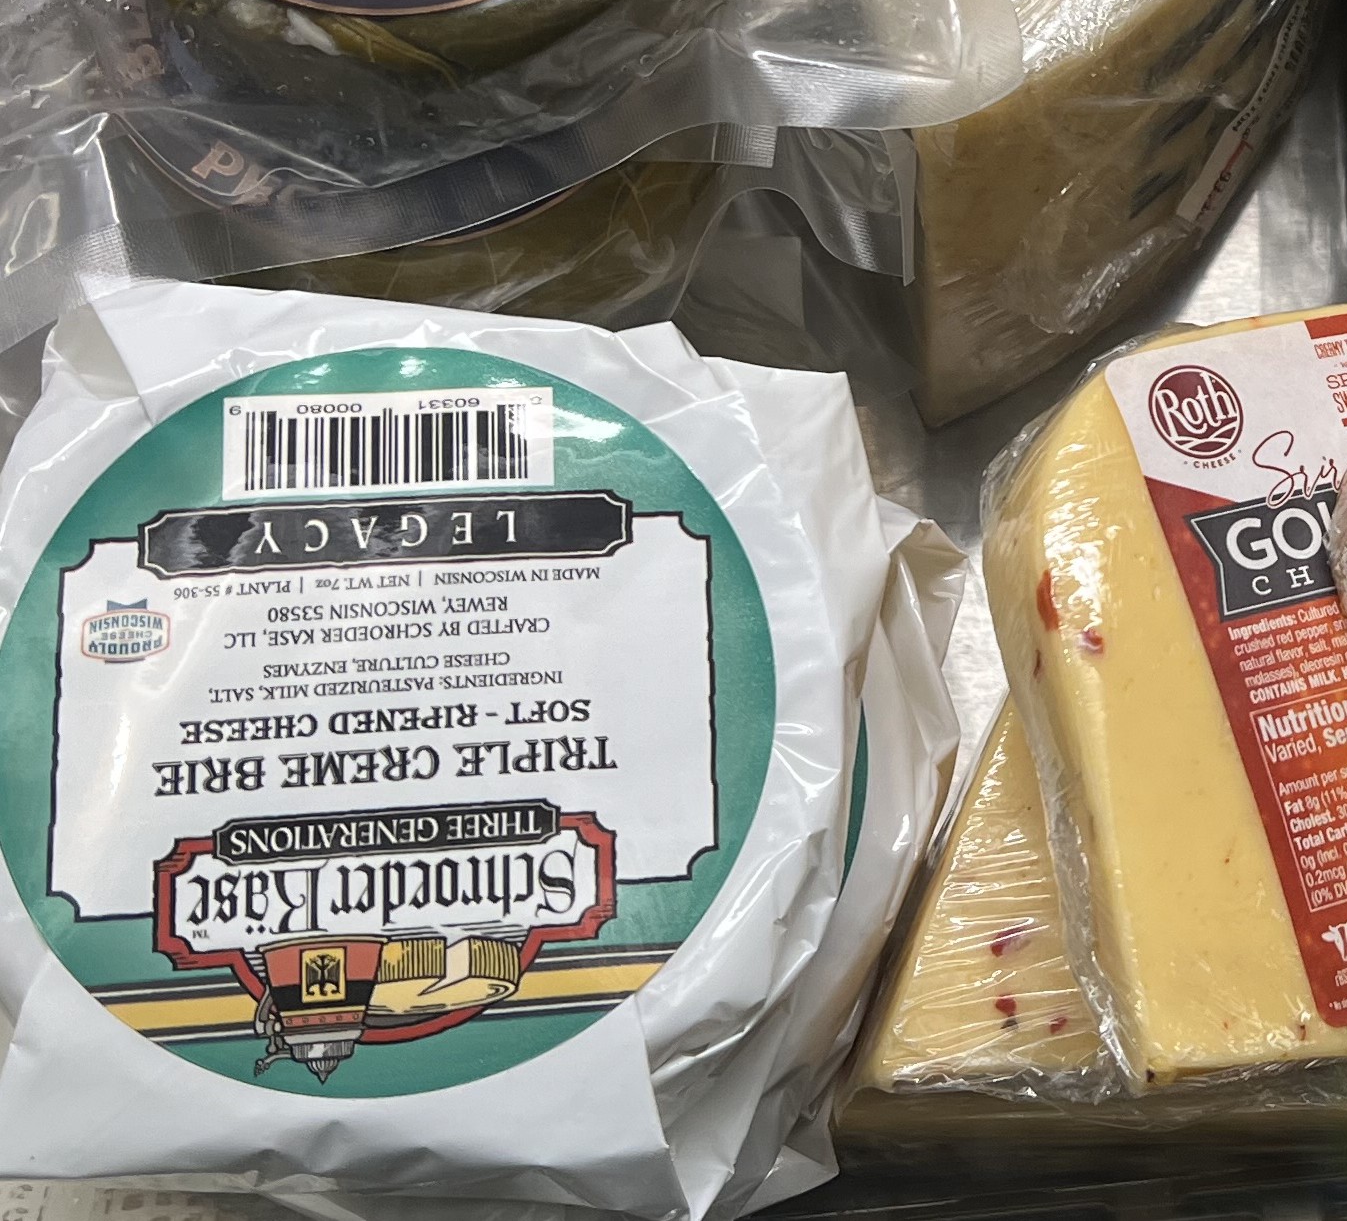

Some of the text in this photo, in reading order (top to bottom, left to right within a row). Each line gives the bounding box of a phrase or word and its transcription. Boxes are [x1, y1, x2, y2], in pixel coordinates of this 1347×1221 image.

[295, 395, 481, 417] 60331 00080
[1155, 371, 1237, 438] Roth
[1192, 453, 1238, 470] CHEESE
[251, 508, 518, 554] LEGACY
[173, 566, 601, 601] MADE IN WISCONSIN NET WT. 7oz PLANT 55-306
[267, 596, 508, 623] REWEY, WISCONSIN 53580
[224, 617, 550, 650] CRAFTED BY SCHROEDER KASE, LLC
[263, 651, 511, 679] CHEESE CULTURE, ENZYMES
[208, 670, 563, 704] INGREDIENTS: PASTEURIZED MILK, SALT,
[179, 698, 591, 745] SOFT RIPENED CHEESE
[151, 735, 619, 797] TRIPLE CREME BRIE
[230, 810, 542, 856] THREE GENERATIONS
[329, 848, 577, 927] Schroeder
